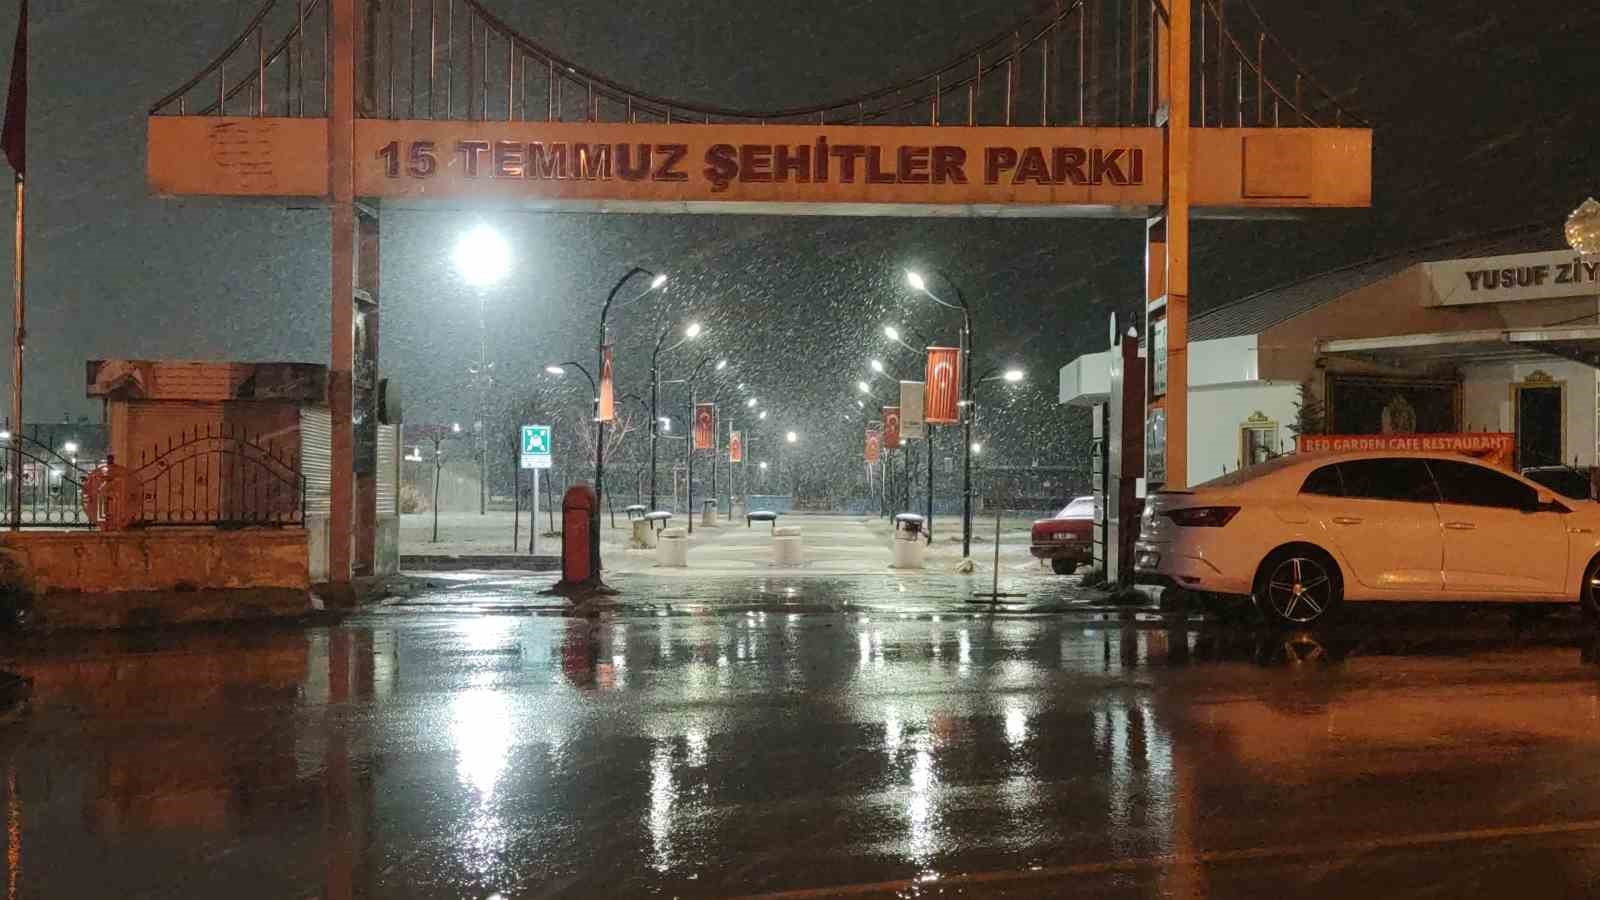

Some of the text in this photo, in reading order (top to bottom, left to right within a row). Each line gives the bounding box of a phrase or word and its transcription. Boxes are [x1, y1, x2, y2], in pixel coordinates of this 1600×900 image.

[376, 135, 1143, 192] 15 TEMMUZ ŞEHİTLER PARKI
[1465, 256, 1600, 290] YUSUF ZİY
[1306, 436, 1508, 450] RED GARDEN CAFE RESTAURANT
